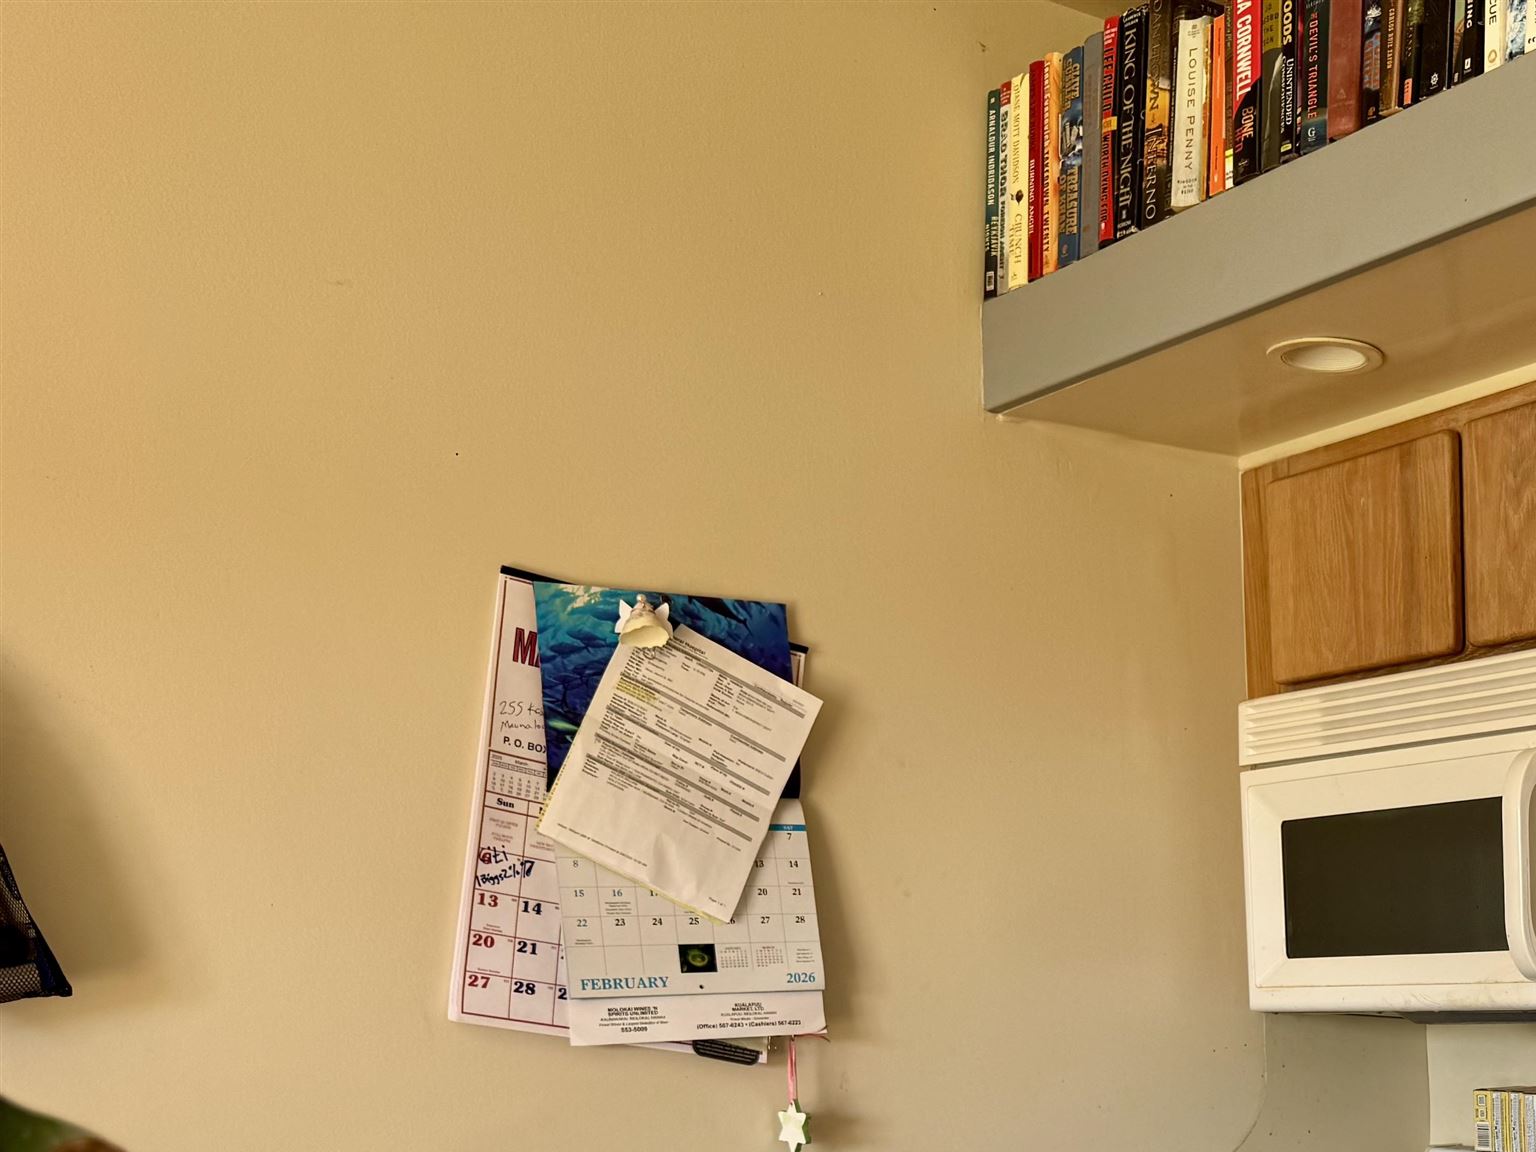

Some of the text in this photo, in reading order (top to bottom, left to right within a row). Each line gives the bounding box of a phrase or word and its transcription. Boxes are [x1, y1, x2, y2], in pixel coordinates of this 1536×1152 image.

[1282, 0, 1292, 46] OODS
[1488, 0, 1497, 25] CUE
[1122, 28, 1136, 79] KING
[1236, 14, 1252, 102] CORNWELL
[1308, 20, 1318, 62] DEVIL'S
[1186, 48, 1198, 108] LOUISE
[1285, 58, 1294, 126] UNINTENDED
[1307, 64, 1318, 120] TRIANGLE
[1122, 85, 1135, 113] OF
[1000, 111, 1008, 153] BRAD
[1121, 114, 1134, 154] THE
[1184, 116, 1196, 170] PENNY
[1241, 106, 1254, 139] BONE
[986, 110, 996, 205] ARNALDUR INDRIDASON
[999, 155, 1008, 198] THOR
[1012, 141, 1020, 184] DAVIDSON
[1144, 127, 1162, 220] INFERNO
[1066, 167, 1078, 235] TREASURE
[1119, 155, 1134, 208] NIGHT
[1014, 214, 1022, 263] CRUNCH
[512, 626, 541, 668] M
[499, 700, 524, 716] 255
[503, 736, 511, 746] P.
[514, 739, 524, 750] O.
[496, 798, 514, 808] Sun
[786, 832, 792, 840] 7
[572, 860, 579, 868] 8
[789, 860, 799, 868] 14
[477, 892, 543, 916] 13 14
[574, 890, 584, 898] 15
[612, 889, 623, 897] 16
[758, 888, 768, 896] 20
[792, 888, 802, 896] 21
[576, 919, 588, 928] 22
[614, 918, 626, 927] 23
[652, 918, 663, 926] 24
[688, 917, 700, 926] 25
[760, 916, 770, 924] 27
[796, 916, 806, 924] 28
[472, 933, 538, 956] 20 21
[467, 974, 568, 1000] 27 28 2
[580, 976, 669, 991] FEBRUARY
[786, 972, 816, 984] 2026
